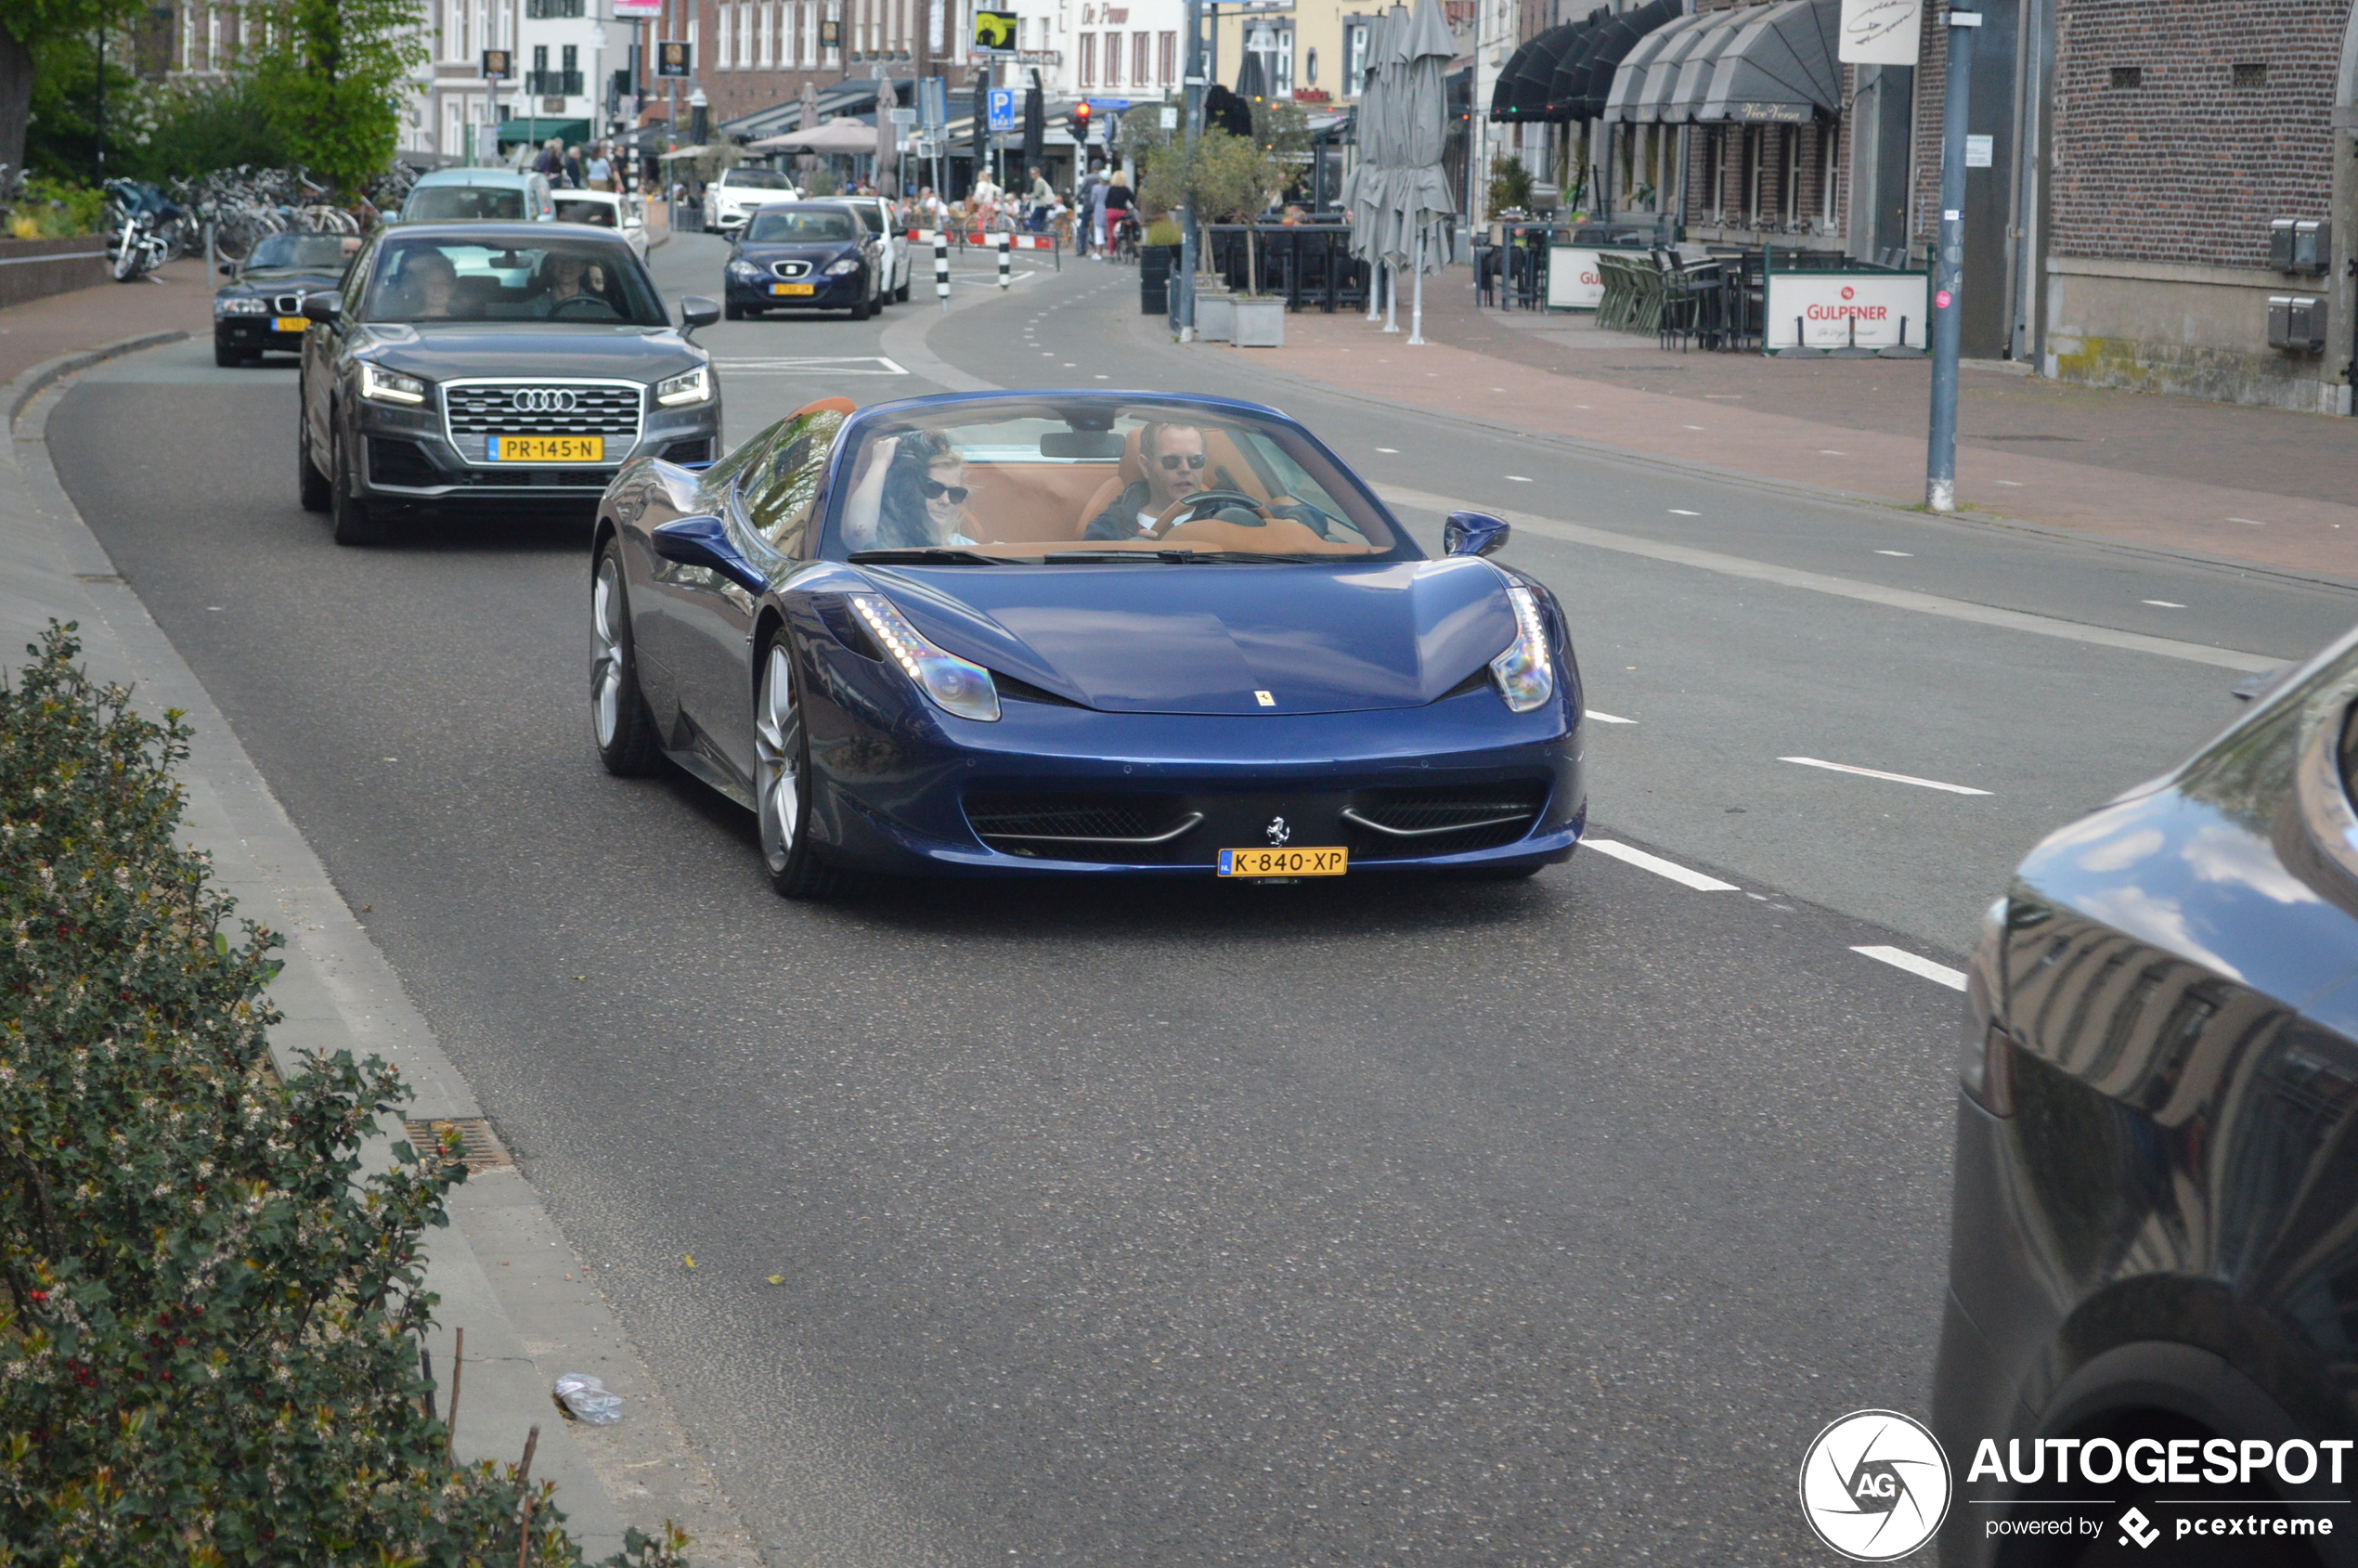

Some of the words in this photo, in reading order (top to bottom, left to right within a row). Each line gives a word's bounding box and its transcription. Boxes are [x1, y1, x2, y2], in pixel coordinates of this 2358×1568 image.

[1082, 3, 1095, 25] De
[993, 93, 1009, 113] P
[1742, 102, 1768, 120] Vice
[1768, 103, 1800, 120] Versa
[1807, 304, 1887, 320] GULPENER
[507, 440, 592, 458] PR-145-N
[1235, 852, 1342, 872] K-840-XP
